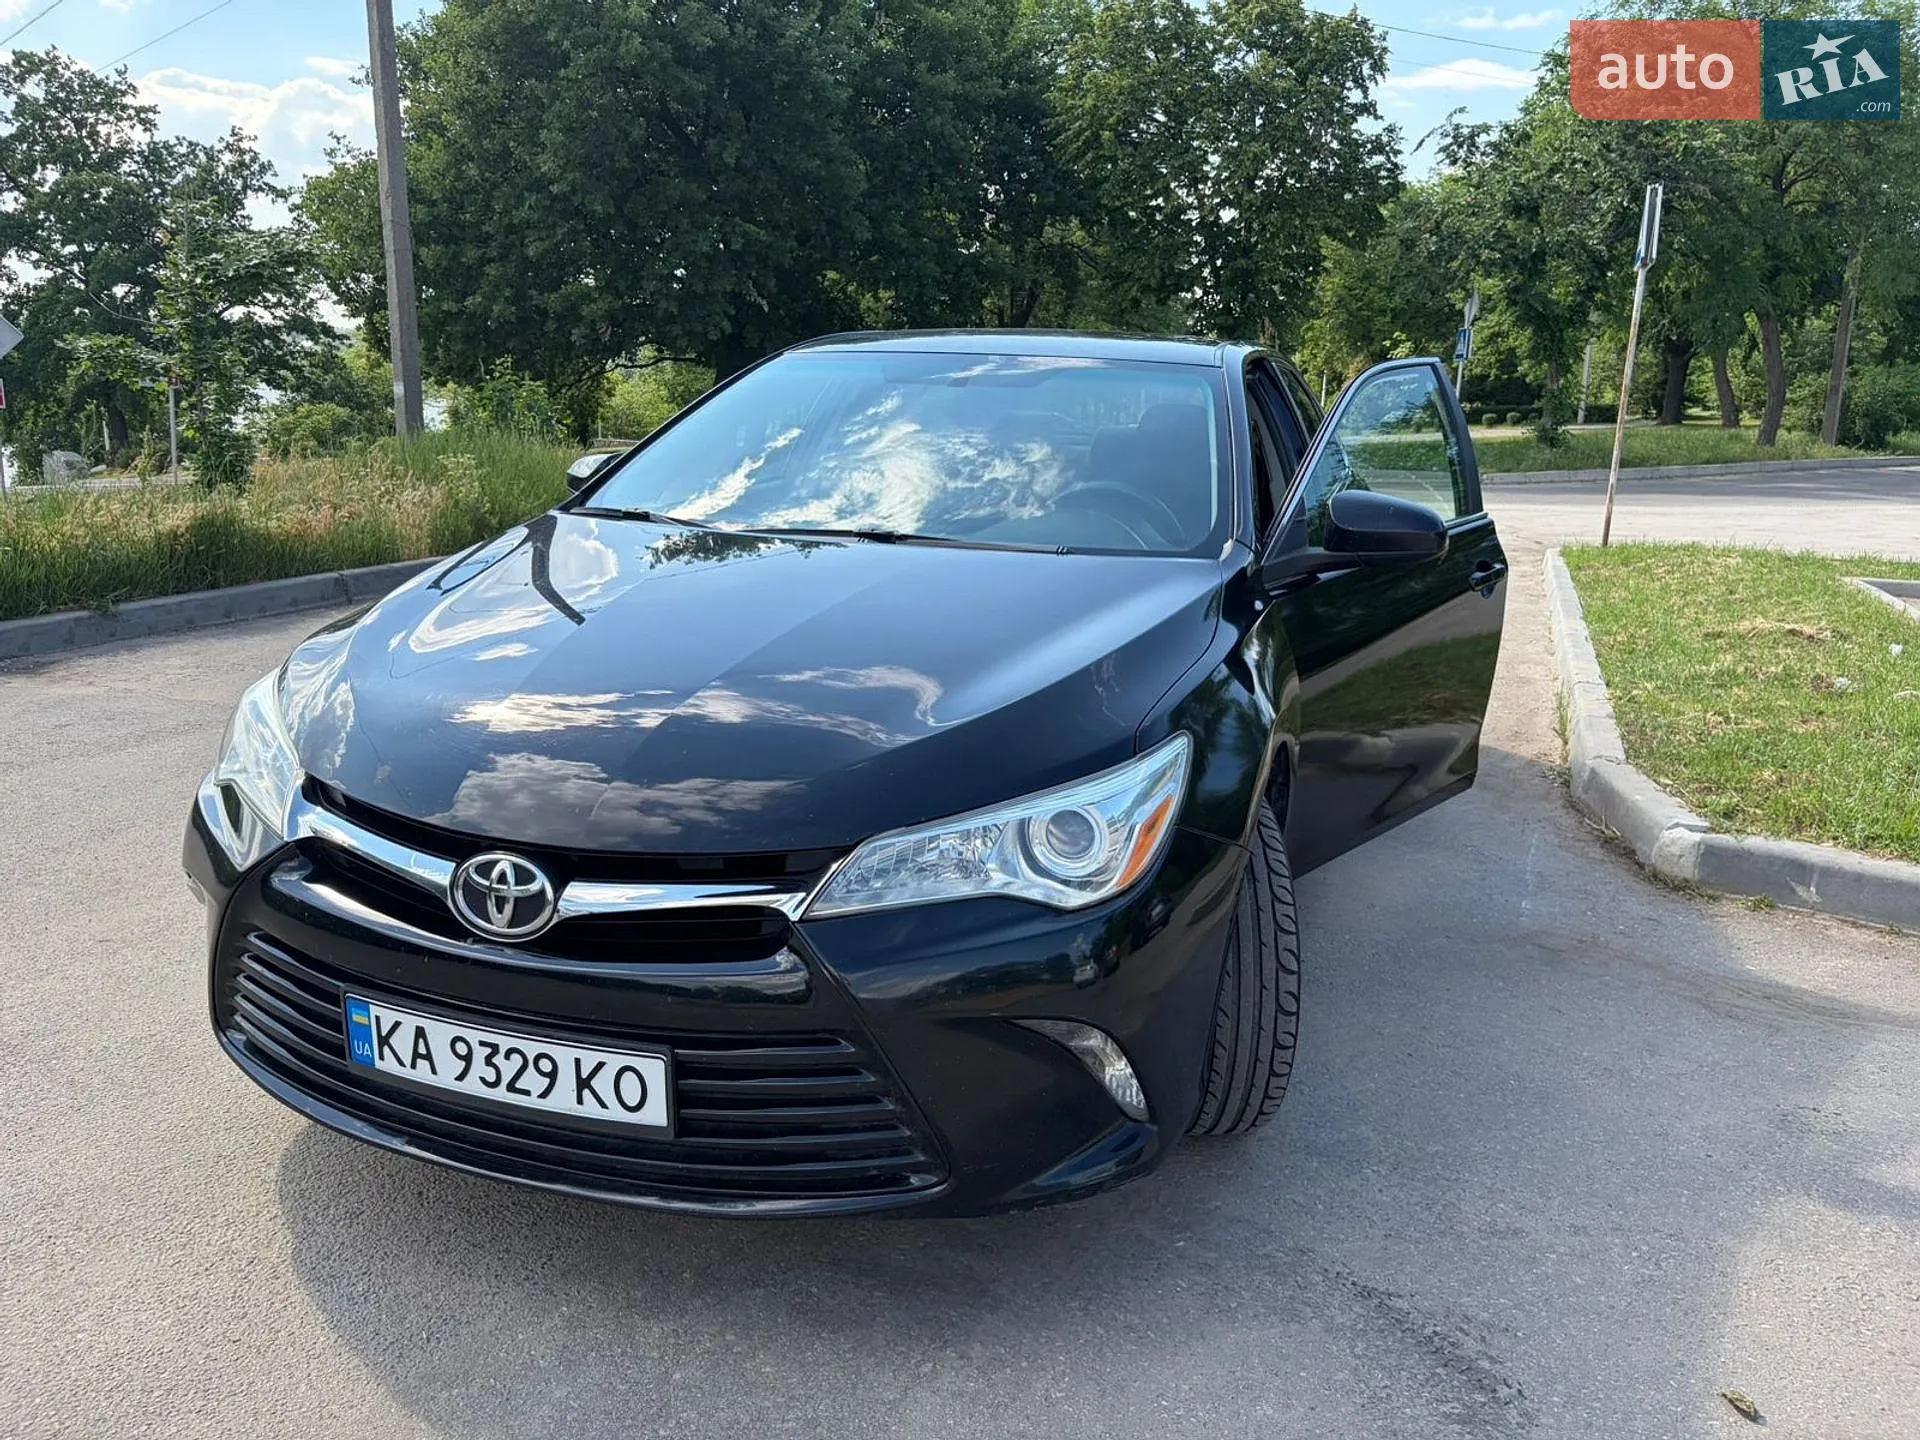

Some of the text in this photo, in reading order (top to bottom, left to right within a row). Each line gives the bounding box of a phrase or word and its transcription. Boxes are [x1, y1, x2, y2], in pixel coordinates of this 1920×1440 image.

[354, 1041, 372, 1058] UA
[375, 1014, 648, 1113] KA 9329 KO
